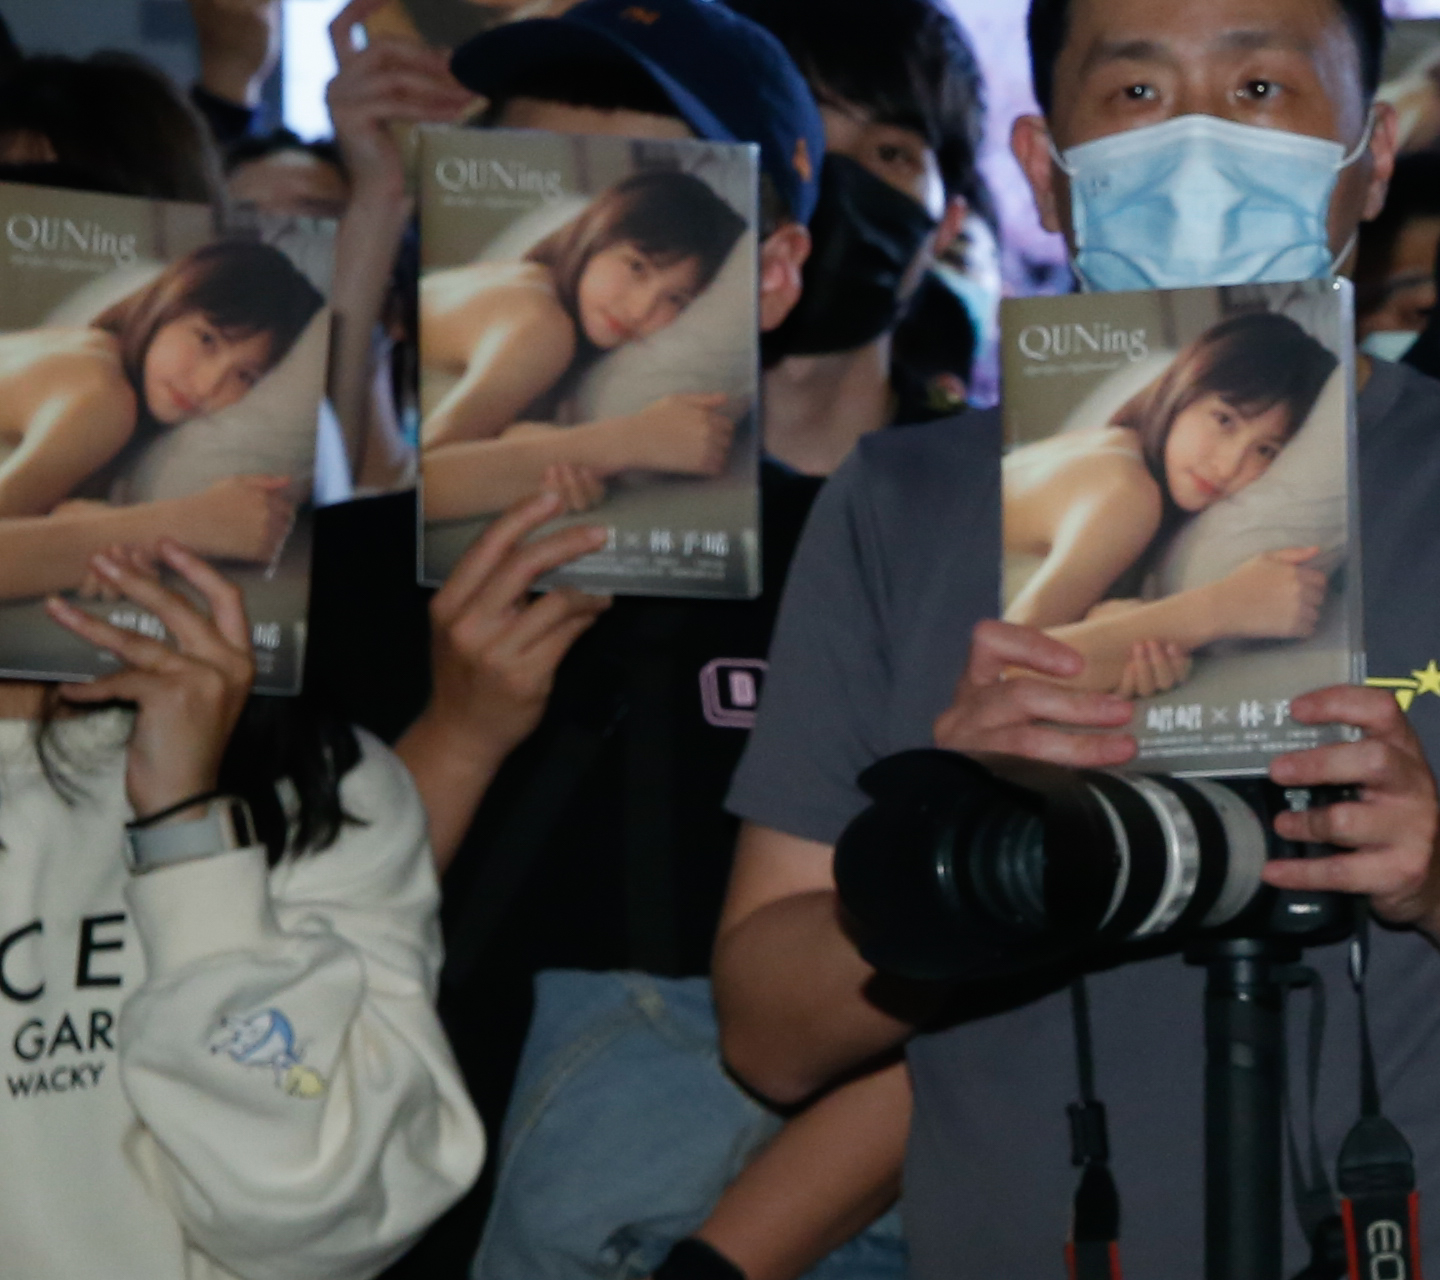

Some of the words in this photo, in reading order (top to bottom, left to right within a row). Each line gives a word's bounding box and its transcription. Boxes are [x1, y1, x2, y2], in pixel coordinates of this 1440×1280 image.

[435, 157, 563, 197] QUNing
[7, 214, 137, 264] QUNing
[1018, 322, 1148, 362] QUNing
[14, 1009, 114, 1062] GAR
[7, 1062, 105, 1098] WACKY
